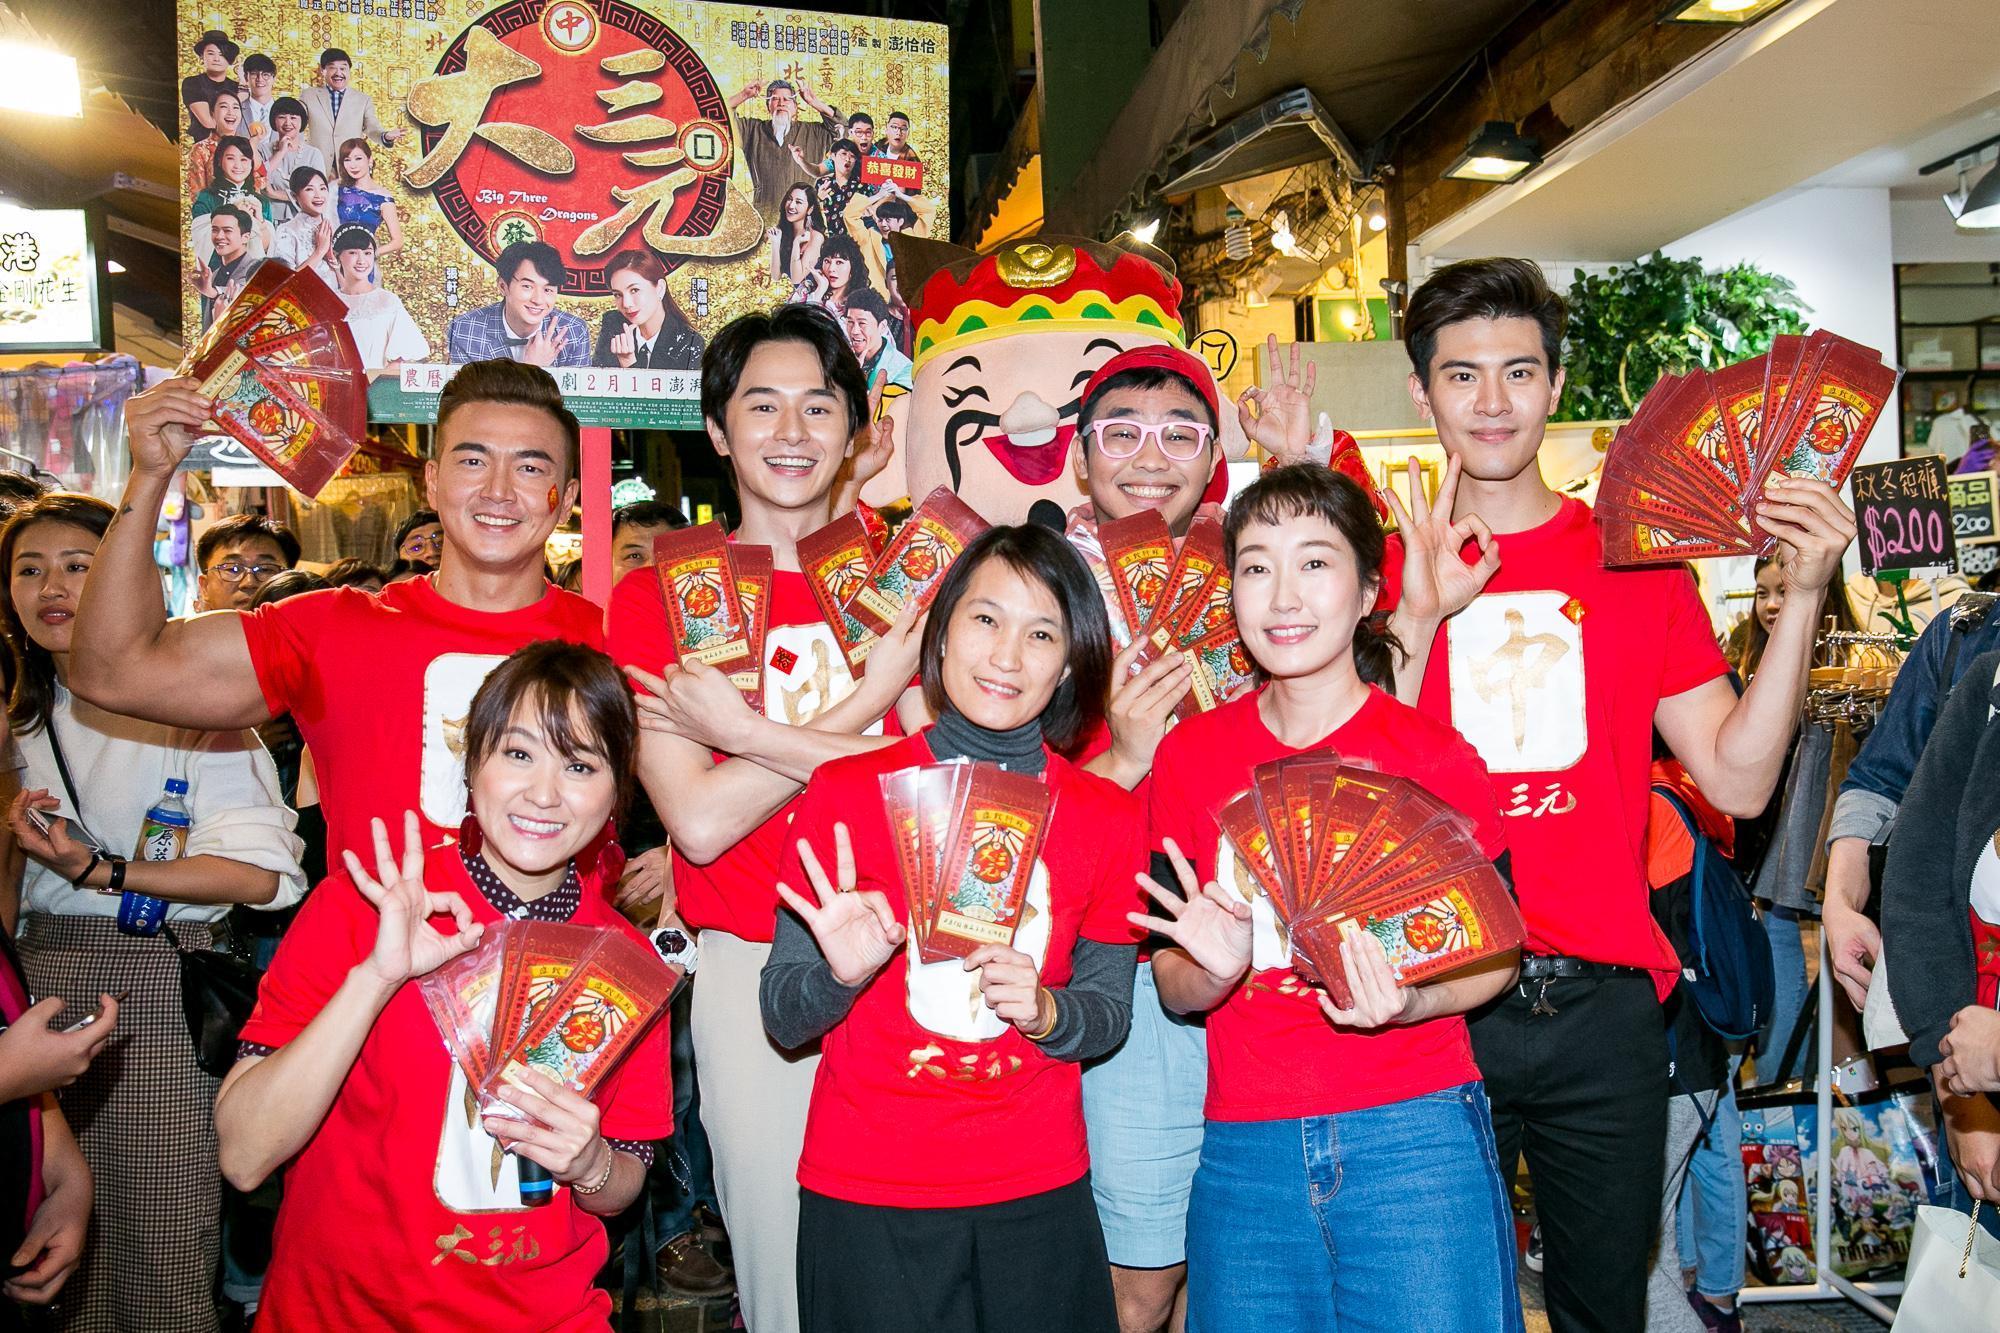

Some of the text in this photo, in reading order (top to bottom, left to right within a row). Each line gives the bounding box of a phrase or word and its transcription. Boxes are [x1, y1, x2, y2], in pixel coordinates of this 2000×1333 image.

[557, 10, 584, 41] 中
[866, 160, 918, 180] 恭喜發財
[475, 188, 548, 205] Big Three
[538, 207, 599, 223] Dragons
[0, 231, 40, 272] 港
[403, 368, 443, 388] 農曆
[1863, 505, 1945, 568] $200
[1952, 513, 1991, 535] 200
[1467, 607, 1571, 755] 中
[1499, 782, 1578, 818] 三元
[431, 1223, 541, 1267] 大三元
